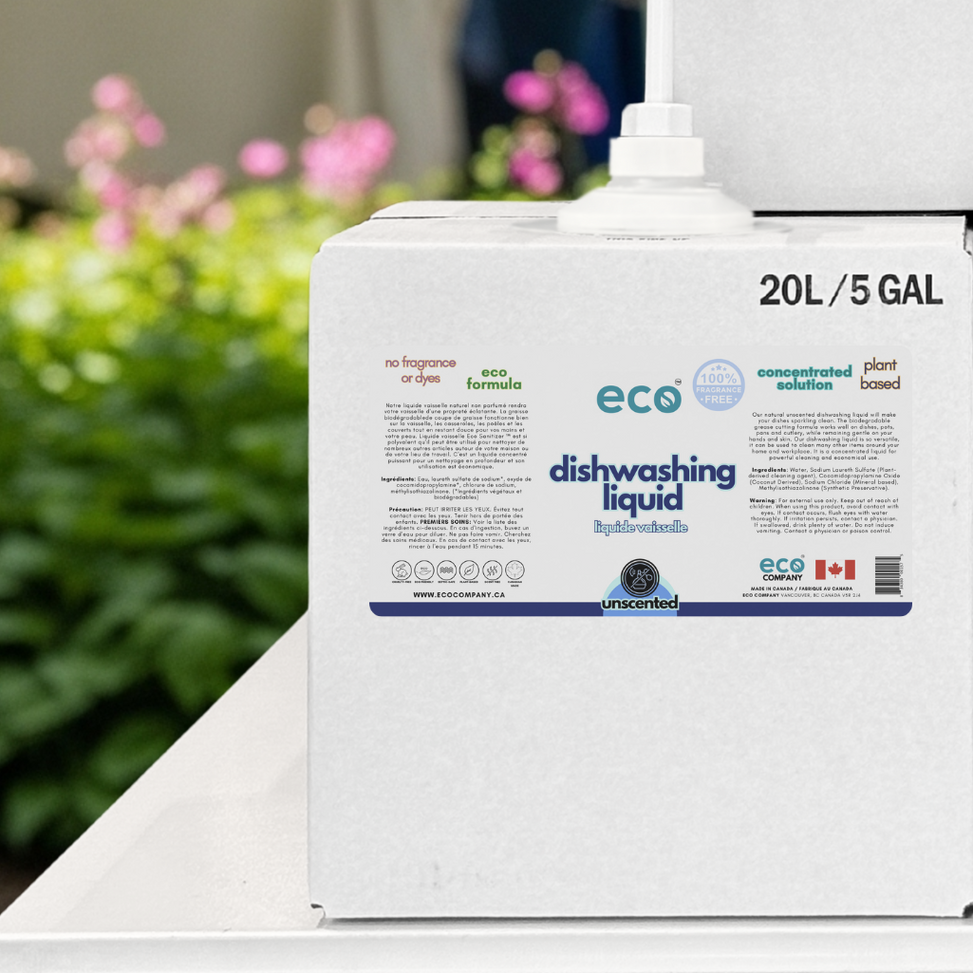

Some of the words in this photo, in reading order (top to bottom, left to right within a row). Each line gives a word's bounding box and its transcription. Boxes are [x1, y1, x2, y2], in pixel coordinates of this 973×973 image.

[878, 274, 944, 305] GAL
[385, 359, 400, 368] no
[401, 355, 457, 371] fragrance
[864, 356, 898, 375] plant
[401, 374, 414, 384] or
[414, 370, 441, 387] dyes
[481, 369, 508, 377] eco
[700, 373, 737, 384] 100%
[756, 364, 853, 379] concentrated
[466, 376, 522, 390] formula
[775, 377, 834, 391] solution
[860, 375, 901, 390] based
[596, 385, 682, 414] eco
[549, 454, 736, 491] dishwashing
[603, 483, 683, 519] liquid
[594, 520, 635, 536] liquide
[637, 520, 688, 533] vaisselle
[759, 558, 805, 573] eco
[762, 573, 803, 582] COMPANY
[601, 595, 679, 610] unscented
